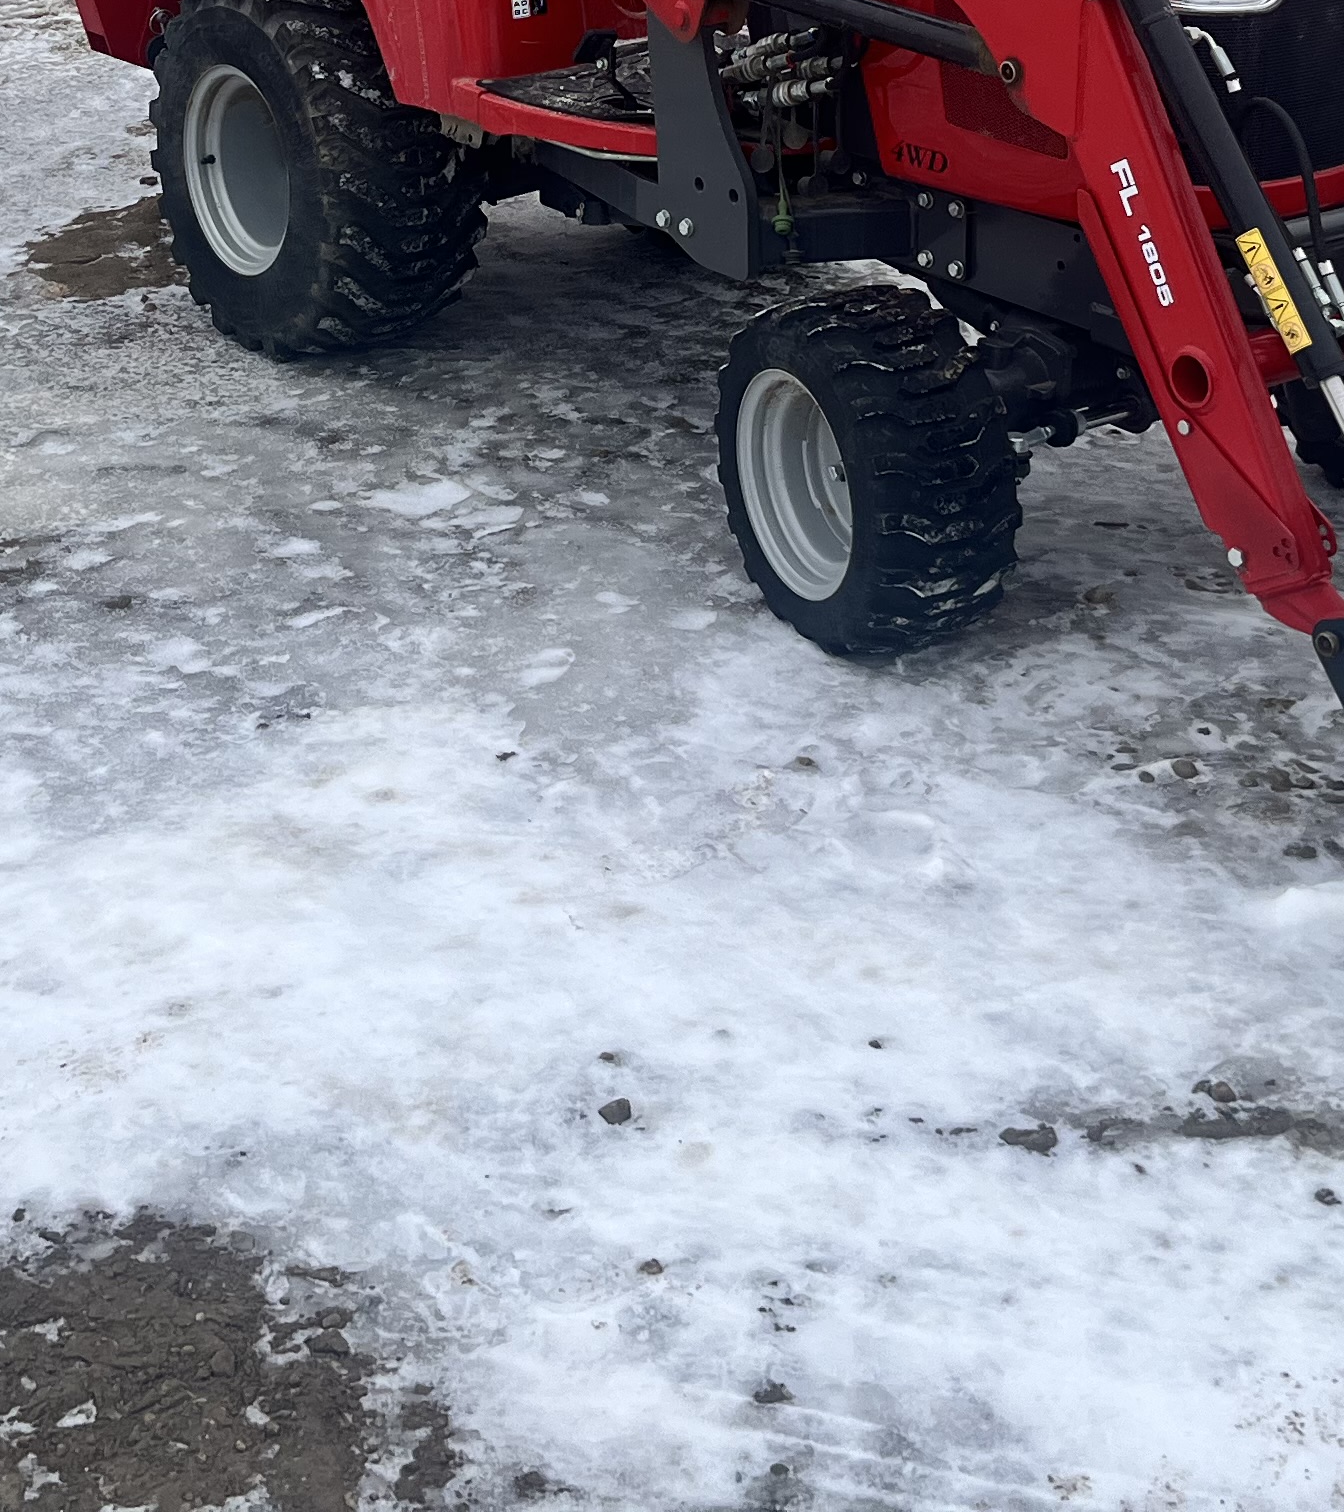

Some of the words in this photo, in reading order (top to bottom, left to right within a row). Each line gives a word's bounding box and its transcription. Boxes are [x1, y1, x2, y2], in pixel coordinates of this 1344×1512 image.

[891, 139, 949, 174] 4WD
[1110, 158, 1139, 217] FL
[1137, 224, 1175, 307] 1805
